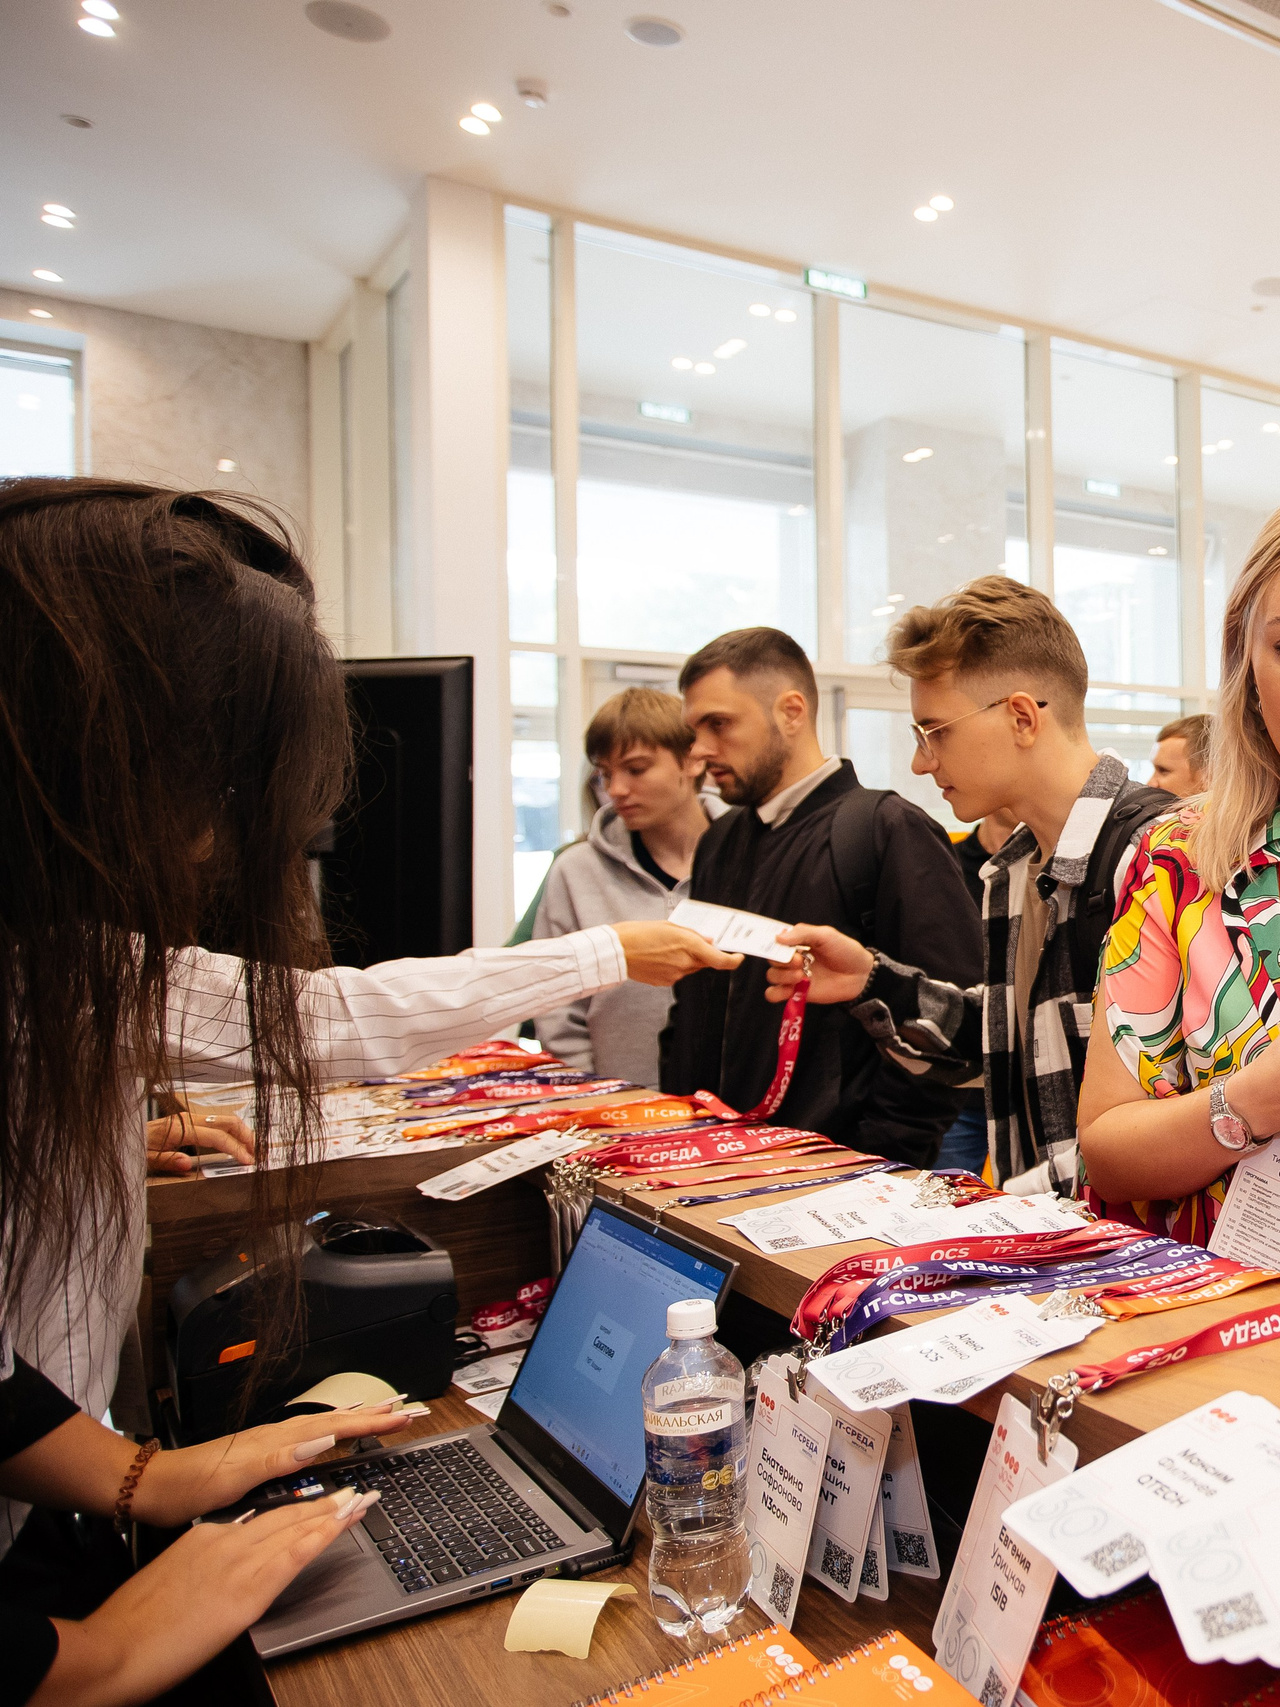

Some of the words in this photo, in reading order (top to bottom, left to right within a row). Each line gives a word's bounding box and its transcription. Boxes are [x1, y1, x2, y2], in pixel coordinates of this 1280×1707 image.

[600, 1110, 628, 1120] OCS
[644, 1108, 692, 1118] IT-СРЕД
[483, 1121, 514, 1133] OCS
[629, 1147, 702, 1164] IT-СРЕДА
[716, 1141, 747, 1154] OCS
[1115, 1237, 1180, 1257] СРЕДА
[833, 1256, 906, 1275] СРЕДА
[930, 1247, 970, 1262] OCS
[943, 1260, 1039, 1275] IT-СРЕДА
[1119, 1253, 1212, 1278] IT-СРЕДА
[876, 1265, 920, 1288] OCS
[893, 1272, 964, 1291] -СРЕДА
[1055, 1278, 1098, 1289] OCS
[1128, 1263, 1215, 1292] IT-СРЕДА
[863, 1290, 967, 1319] IT-СРЕДА
[989, 1282, 1034, 1291] OCS
[1153, 1278, 1244, 1305] IT-СРЕДА
[474, 1307, 519, 1329] -СРЕДА
[989, 1304, 1010, 1316] OCS
[956, 1333, 985, 1353] Алена
[760, 1392, 776, 1411] OCS
[791, 1426, 819, 1455] IT-СРЕДА
[835, 1418, 875, 1451] IT-СРЕДА
[996, 1424, 1008, 1442] OC
[761, 1446, 804, 1493] Екатерина
[825, 1455, 845, 1475] гей
[1003, 1451, 1020, 1475] OCS
[1177, 1447, 1235, 1484] Максим
[756, 1462, 803, 1513] Сафронова
[761, 1491, 789, 1527] N3com
[998, 1525, 1032, 1574] Евгения
[991, 1542, 1027, 1598] Урицкая
[989, 1580, 1008, 1612] ISIB
[765, 1643, 804, 1676] OCS
[888, 1654, 934, 1692] OCS
